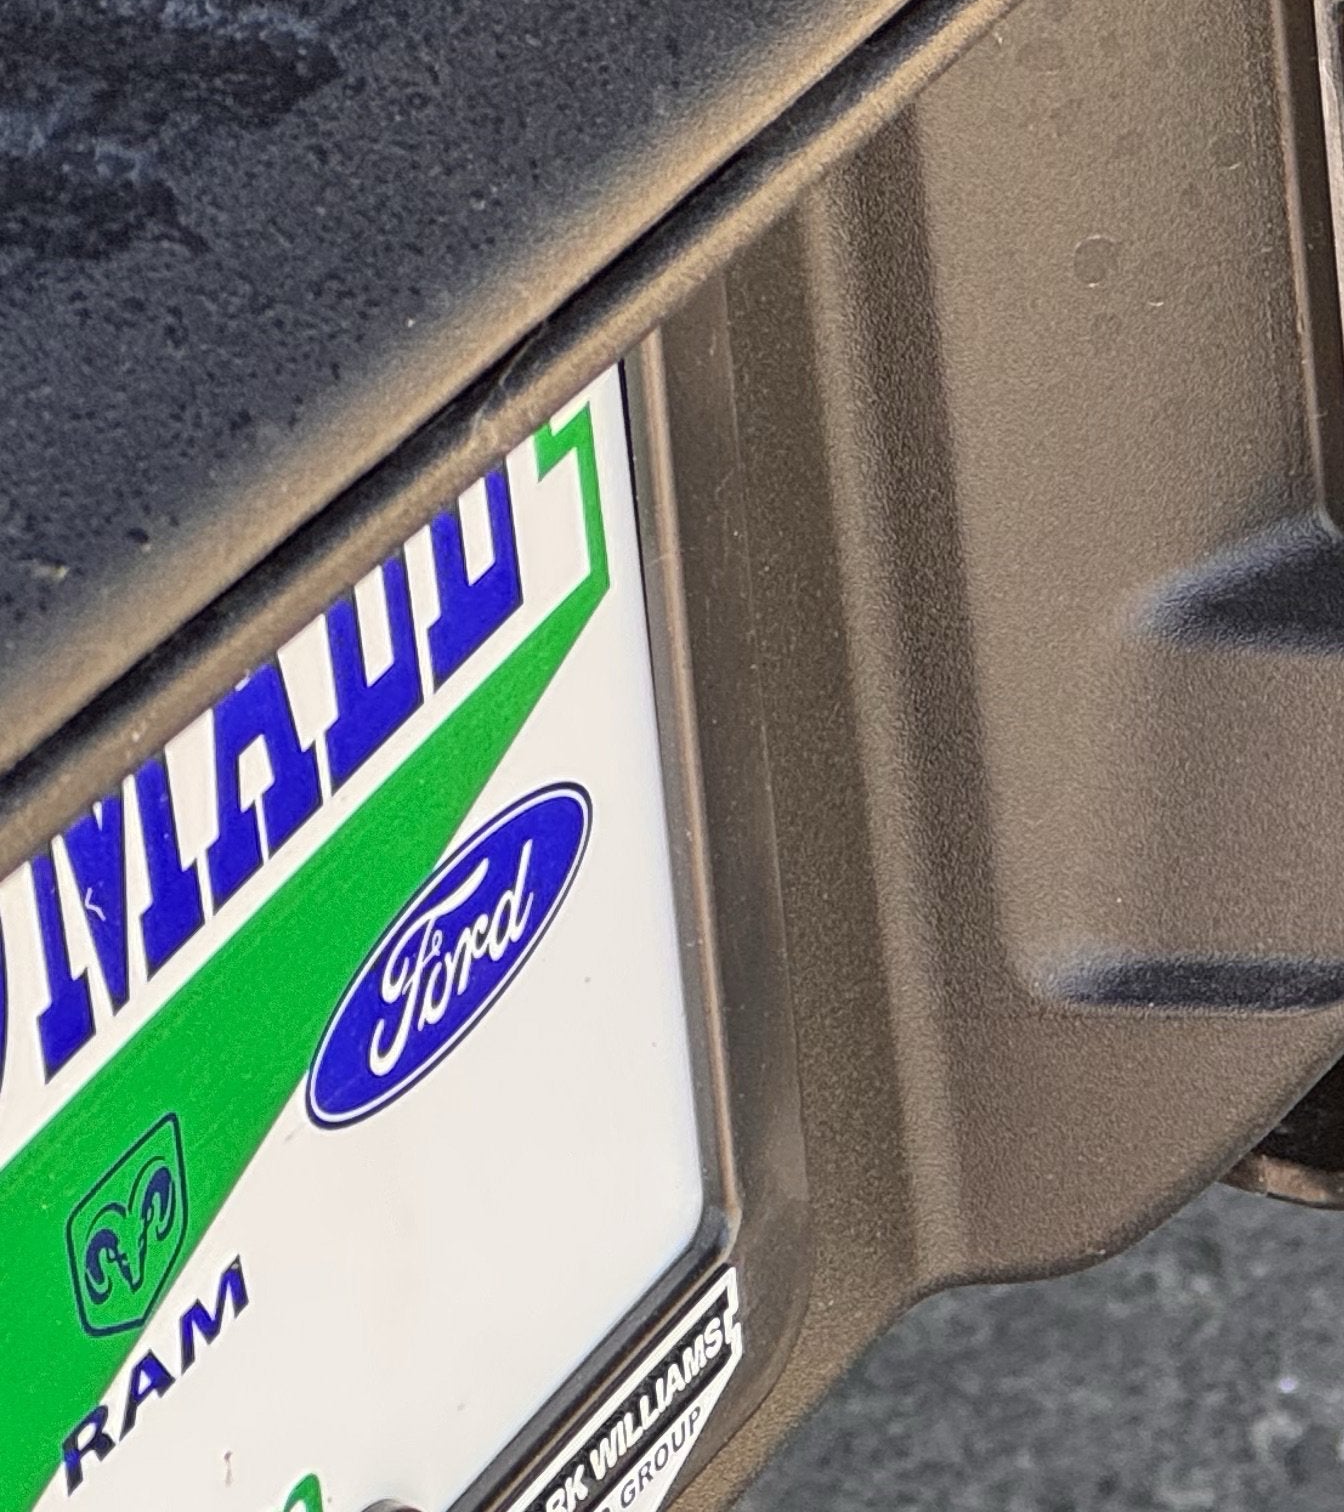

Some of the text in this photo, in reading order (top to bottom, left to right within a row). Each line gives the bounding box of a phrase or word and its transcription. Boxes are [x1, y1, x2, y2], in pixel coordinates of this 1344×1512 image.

[369, 838, 534, 1077] Ford
[60, 1255, 249, 1496] RAM
[588, 1316, 722, 1481] WILLIAMS
[620, 1405, 702, 1509] GROUP
